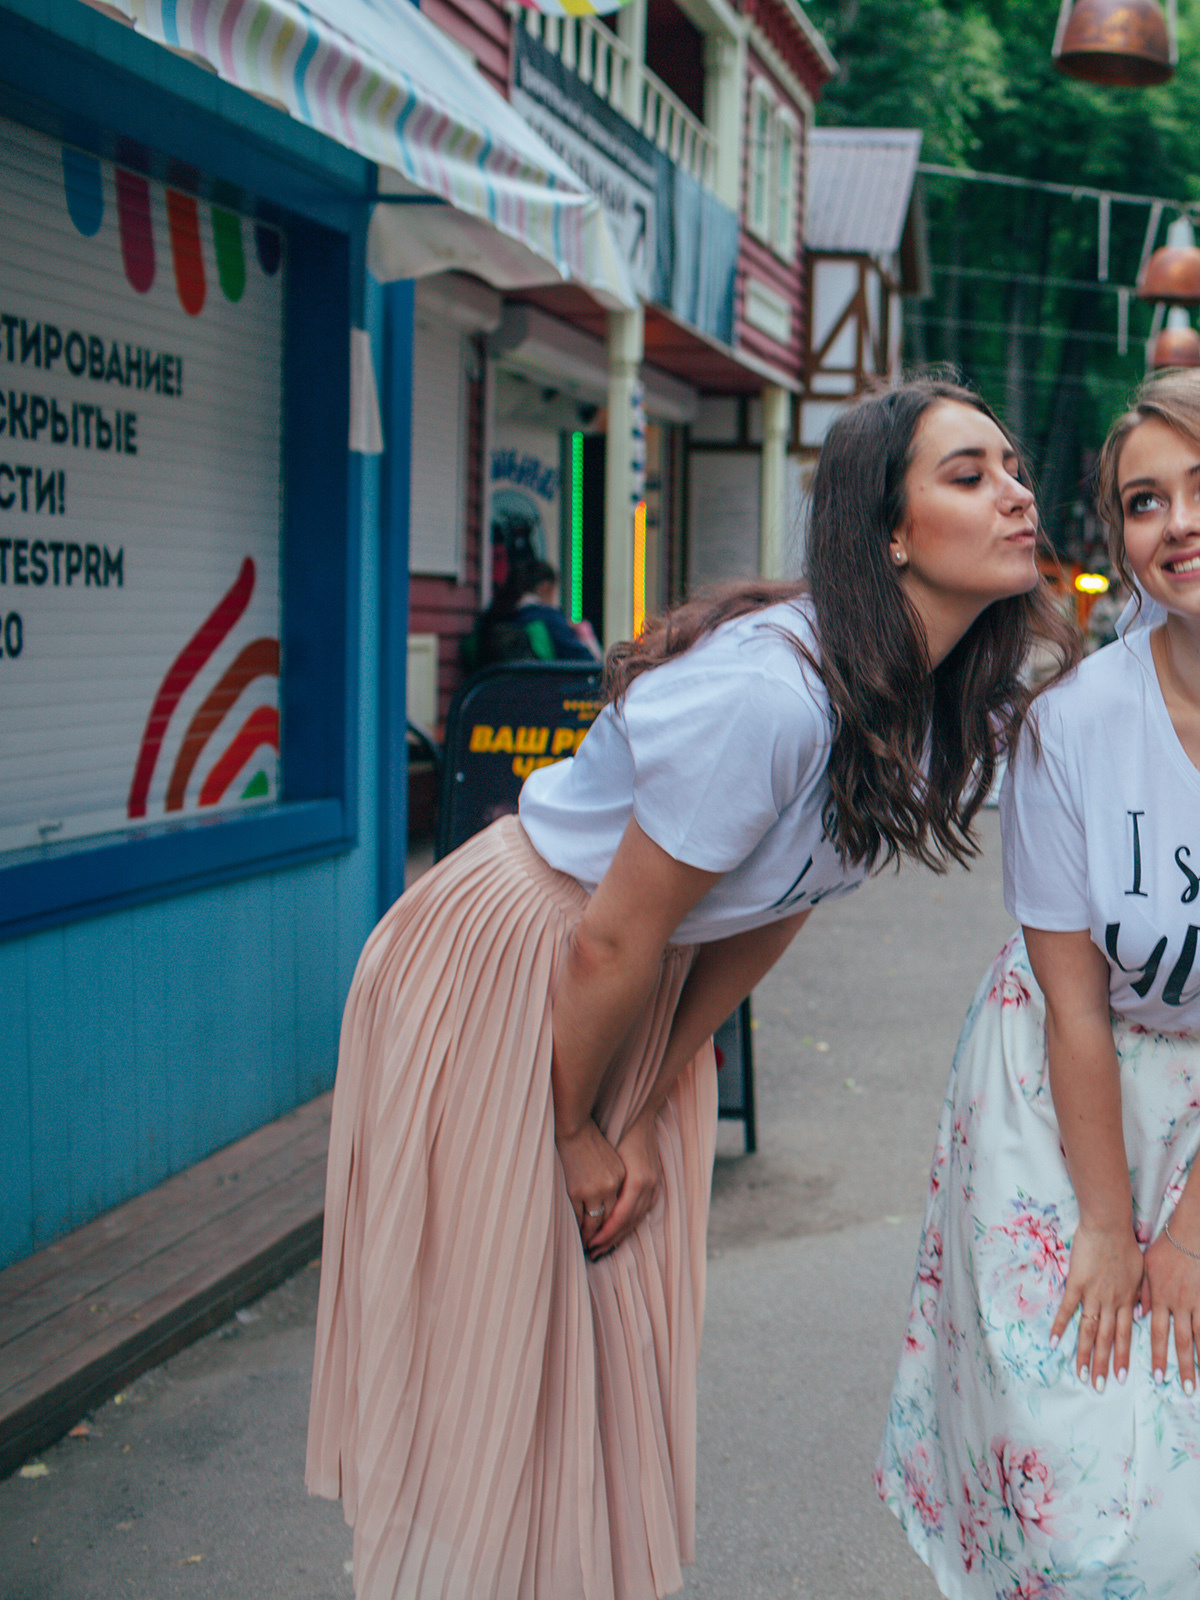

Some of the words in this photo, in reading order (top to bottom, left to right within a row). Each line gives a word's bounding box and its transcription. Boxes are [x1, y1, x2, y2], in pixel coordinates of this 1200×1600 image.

[0, 313, 183, 397] ТИРОВАНИЕ!
[469, 724, 550, 754] ВАШ
[1124, 811, 1149, 897] I
